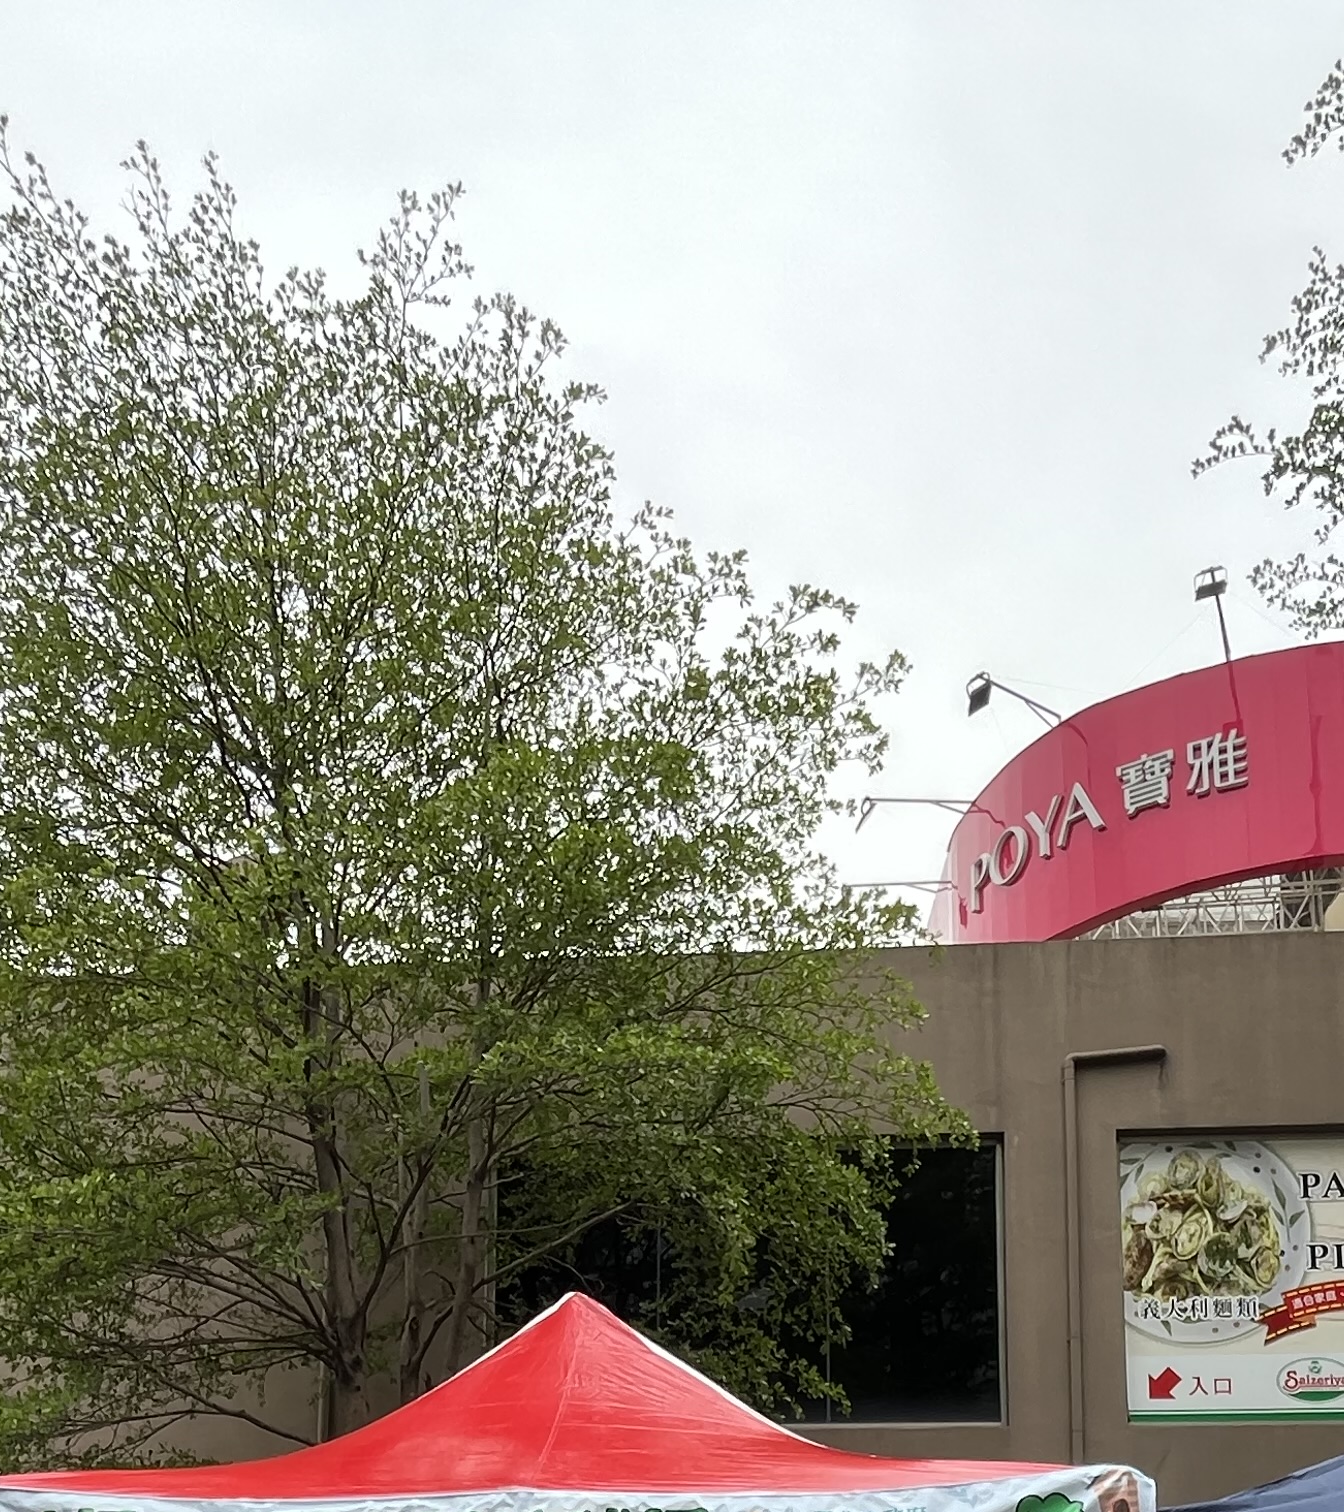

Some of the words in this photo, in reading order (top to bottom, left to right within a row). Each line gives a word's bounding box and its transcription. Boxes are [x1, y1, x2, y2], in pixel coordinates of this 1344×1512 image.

[1114, 727, 1250, 820] 寶雅
[967, 782, 1108, 914] POYA
[1189, 1376, 1232, 1396] 入口
